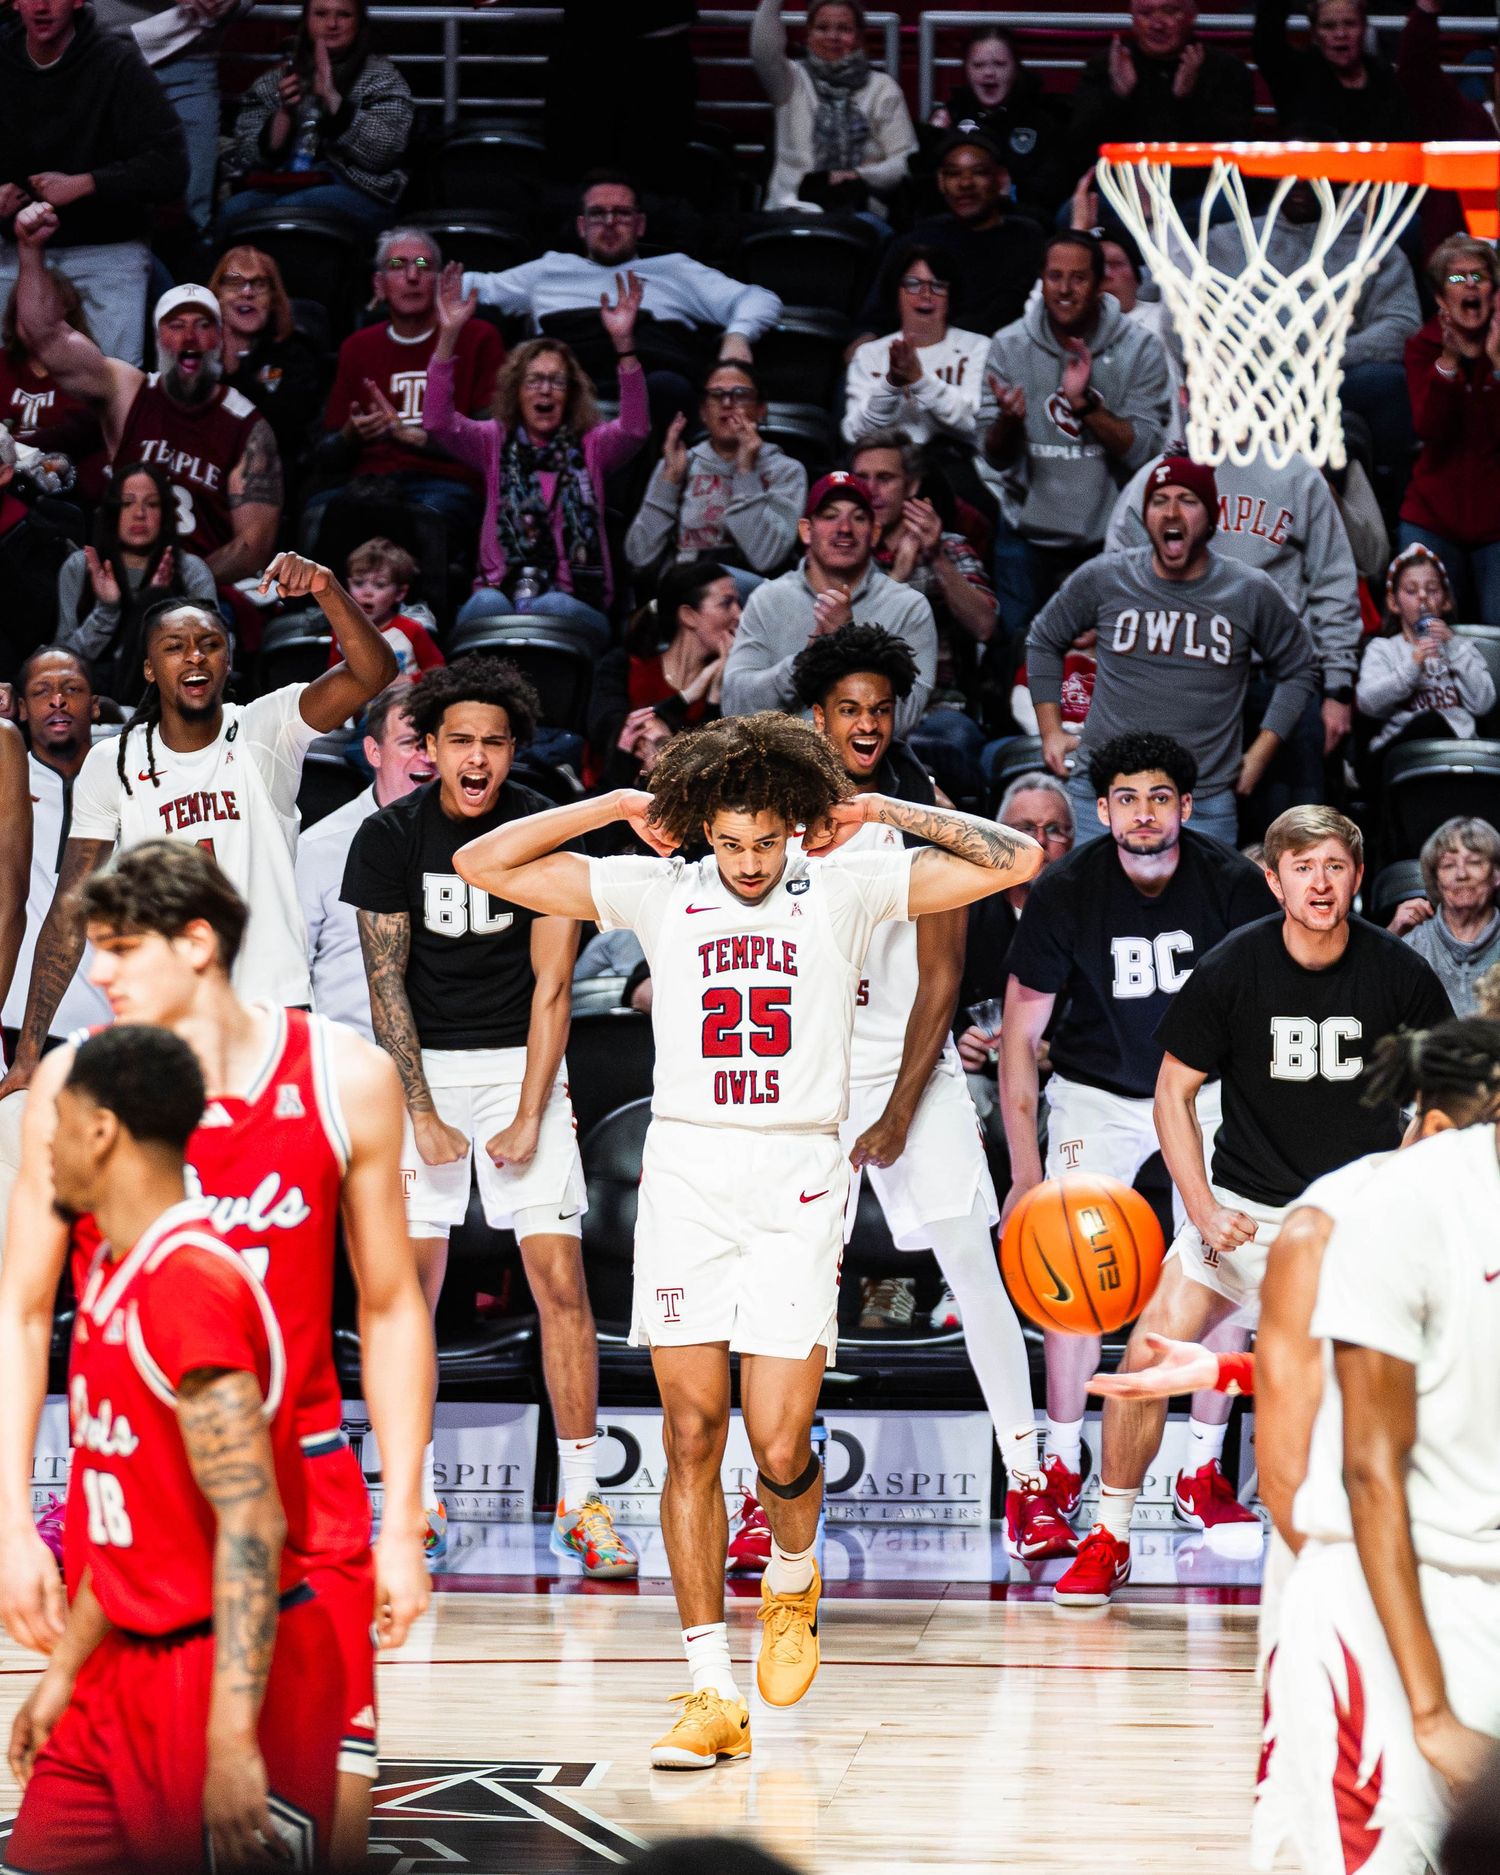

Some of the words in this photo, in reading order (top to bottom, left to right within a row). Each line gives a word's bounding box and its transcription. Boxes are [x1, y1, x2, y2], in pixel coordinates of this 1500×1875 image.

[11, 387, 55, 435] T
[141, 439, 222, 490] TEPLE
[1155, 465, 1171, 483] T
[1112, 608, 1233, 666] OWLS
[159, 790, 241, 835] TEMPLE
[791, 880, 808, 893] BC
[698, 935, 798, 978] TEMPLE
[1110, 929, 1194, 999] BC
[701, 986, 792, 1058] 25
[1270, 1016, 1364, 1081] BC
[714, 1070, 779, 1105] OWLS
[1060, 1140, 1084, 1169] T
[656, 1288, 685, 1322] T
[826, 1429, 977, 1495] DASPIT
[82, 1469, 134, 1547] 18
[882, 1507, 982, 1519] LAWYERS
